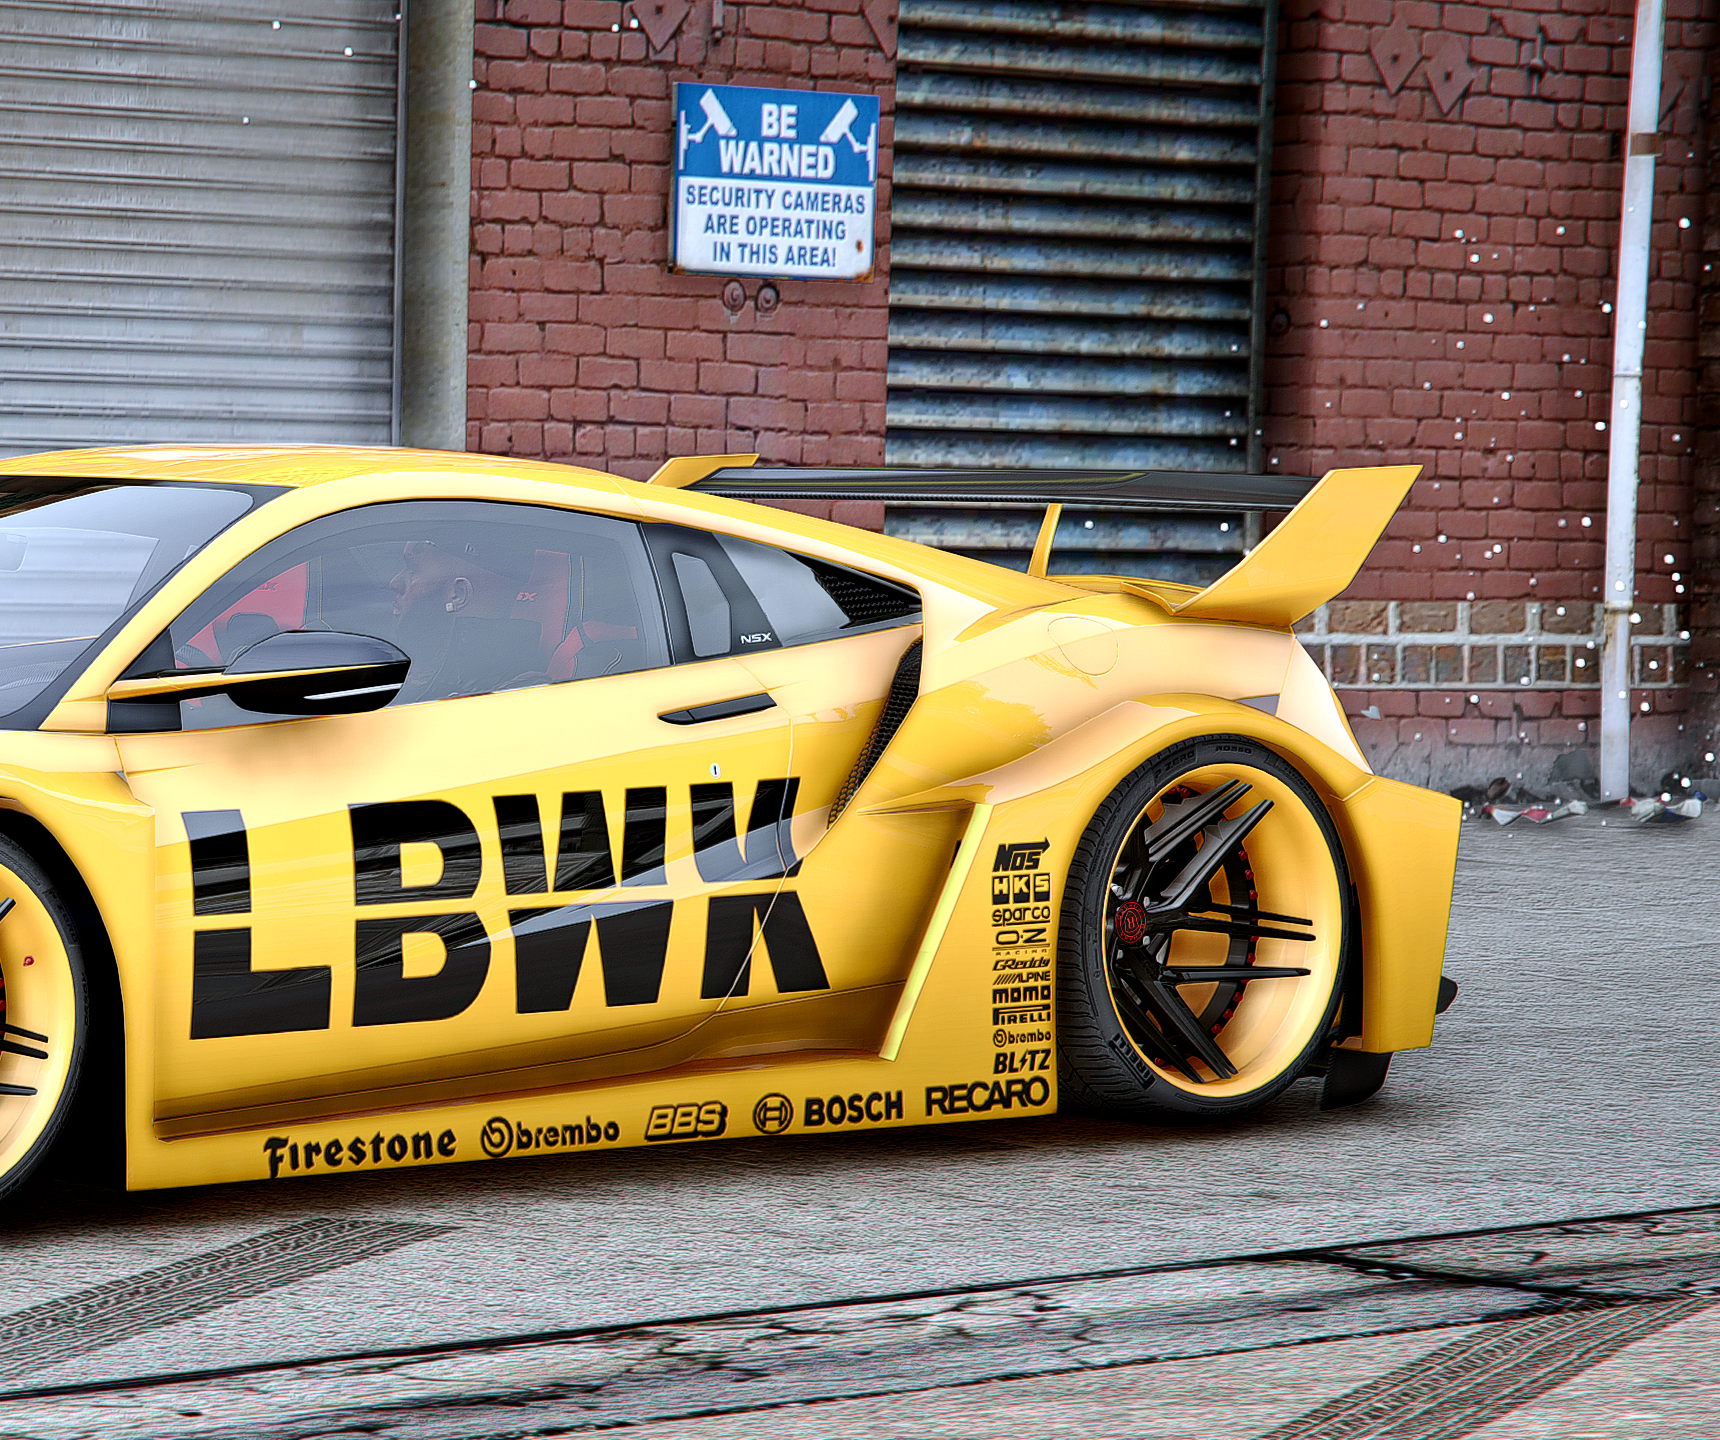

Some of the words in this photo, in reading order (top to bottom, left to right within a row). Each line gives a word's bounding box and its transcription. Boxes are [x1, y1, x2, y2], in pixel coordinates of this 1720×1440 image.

[761, 103, 798, 140] BE
[719, 139, 837, 180] WARNED
[686, 184, 776, 210] SECURITY
[782, 189, 866, 215] CAMERAS
[703, 213, 740, 235] ARE
[746, 215, 847, 241] OPERATING
[712, 241, 731, 263] IN
[737, 242, 779, 265] THIS
[783, 245, 838, 268] AREA!
[740, 632, 773, 645] NSX
[992, 836, 1051, 872] NOS
[992, 873, 1051, 904] HKS
[181, 776, 831, 1040] LBWK
[992, 906, 1051, 927] sparco
[1012, 971, 1051, 985] ALPINE
[992, 1004, 1051, 1026] PIRELLI
[1008, 1029, 1051, 1044] brembo
[1109, 1033, 1157, 1090] PIRELLI
[803, 1090, 903, 1127] BOSCH
[925, 1077, 1050, 1117] RECARO
[516, 1115, 621, 1151] brembo
[644, 1102, 727, 1141] BBS
[263, 1129, 457, 1179] Firestone
